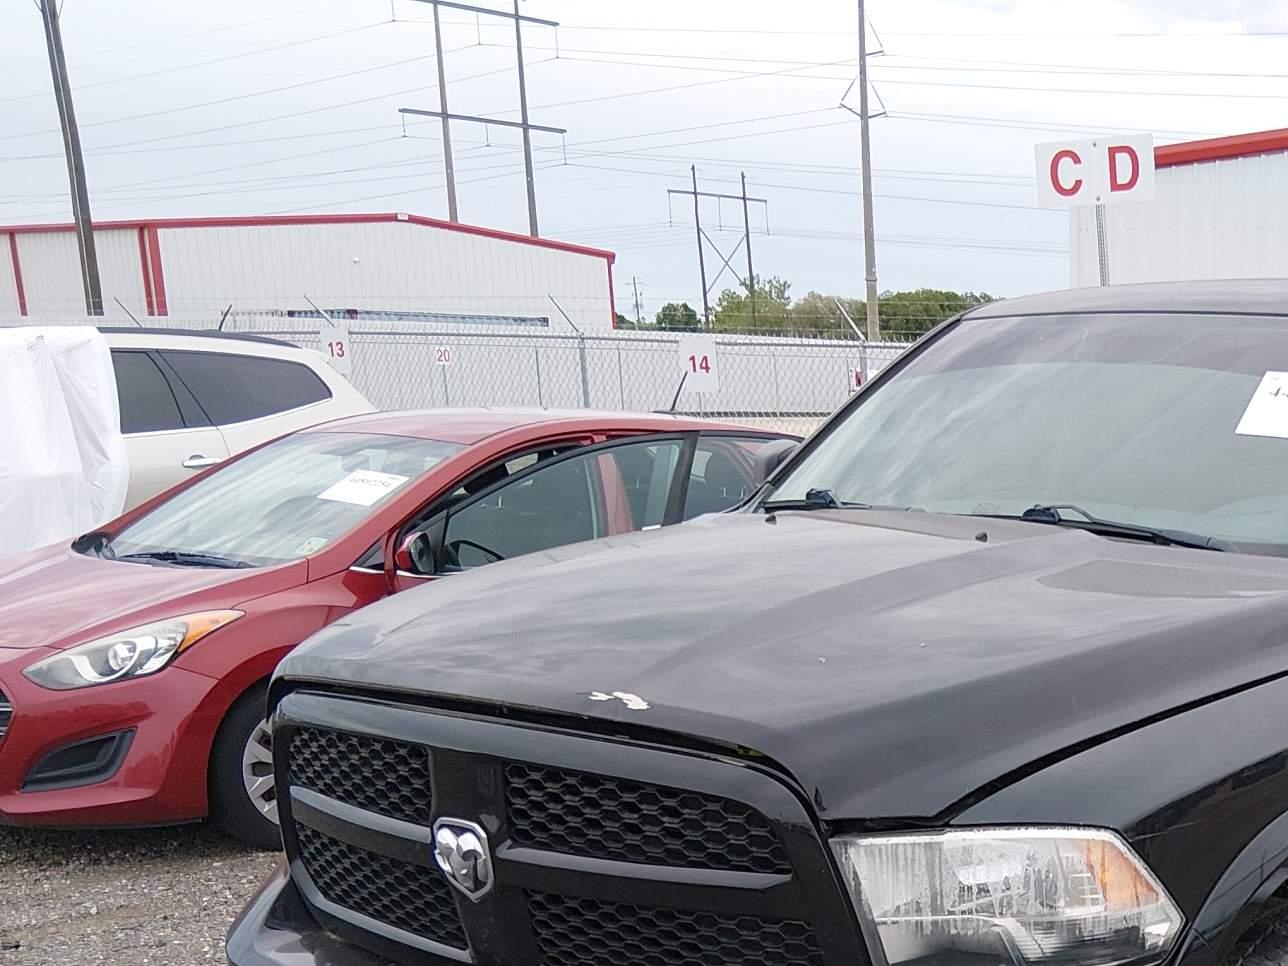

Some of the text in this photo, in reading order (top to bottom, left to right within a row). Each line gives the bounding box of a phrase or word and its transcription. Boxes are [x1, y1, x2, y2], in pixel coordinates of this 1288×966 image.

[1050, 145, 1140, 197] C D
[327, 341, 345, 358] 13
[436, 348, 450, 363] 20
[688, 355, 711, 374] 14
